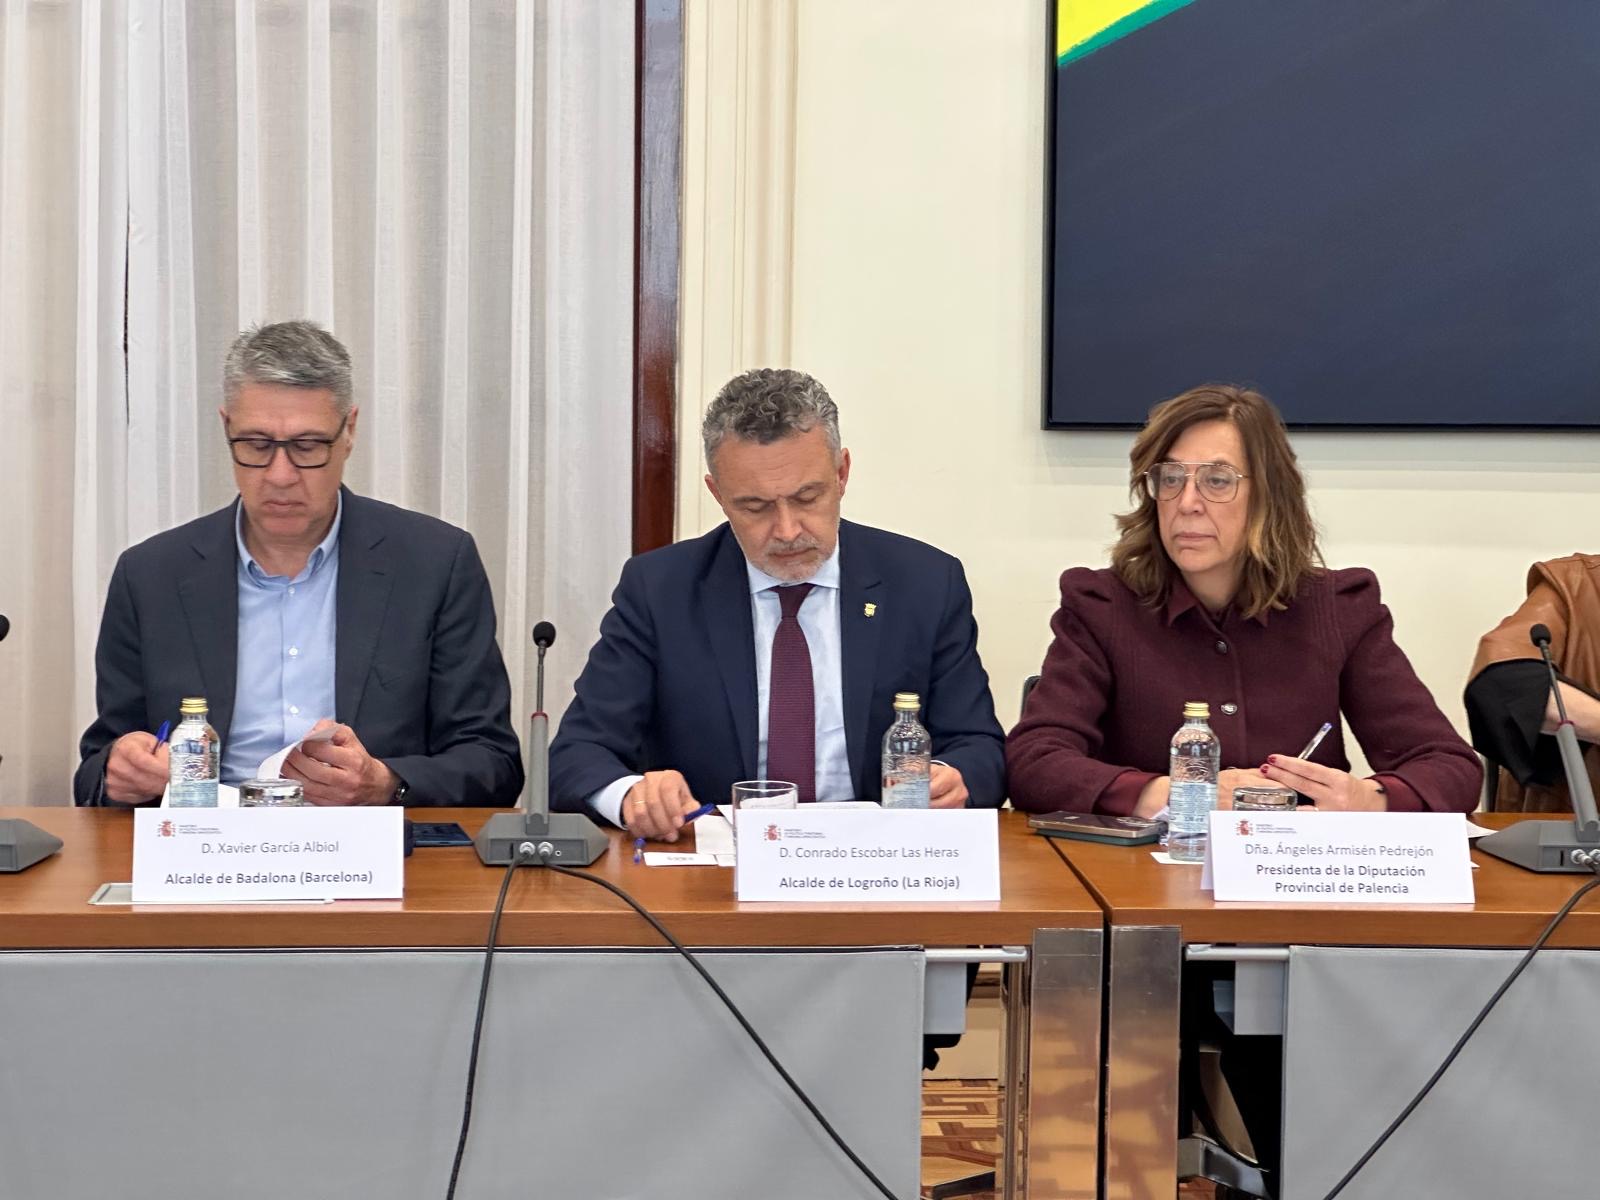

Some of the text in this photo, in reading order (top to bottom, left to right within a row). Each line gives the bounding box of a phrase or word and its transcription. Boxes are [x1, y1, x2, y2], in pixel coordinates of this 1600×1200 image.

[201, 840, 340, 854] D. Xavier García Albiol
[779, 846, 960, 859] D. Conrado Escobar Las Heras
[1244, 841, 1434, 859] Dña. Ángeles Armisén Pedrejón
[163, 870, 373, 886] Alcalde de Badalona (Barcelona)
[1255, 863, 1426, 879] Presidenta de la Diputación
[778, 874, 961, 891] Alcalde de Logroño (La Rioja)
[1274, 880, 1410, 894] Provincial de Palencia
